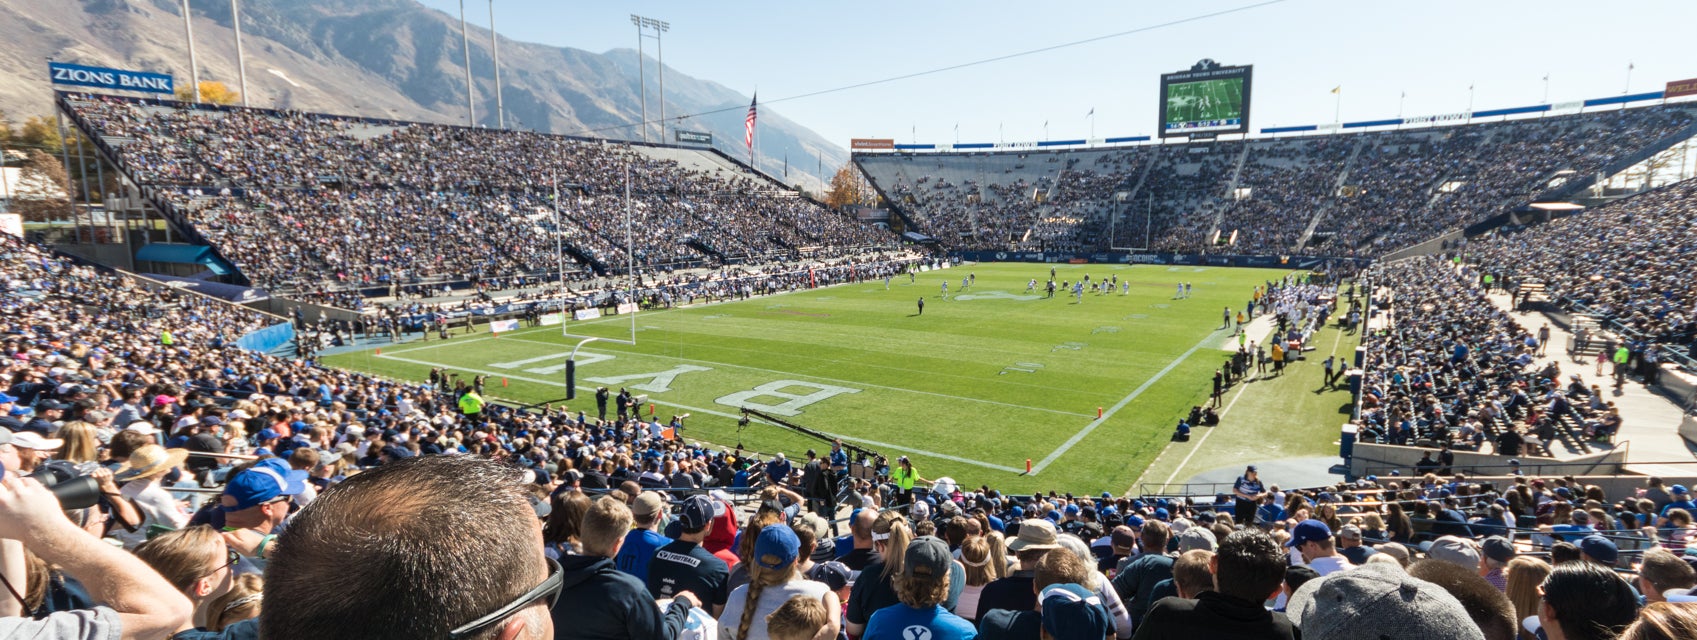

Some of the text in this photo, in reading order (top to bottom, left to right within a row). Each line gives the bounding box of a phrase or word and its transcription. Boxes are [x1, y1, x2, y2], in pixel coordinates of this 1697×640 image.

[53, 67, 171, 90] ZIONS BANK
[670, 553, 697, 566] FOOTBALL
